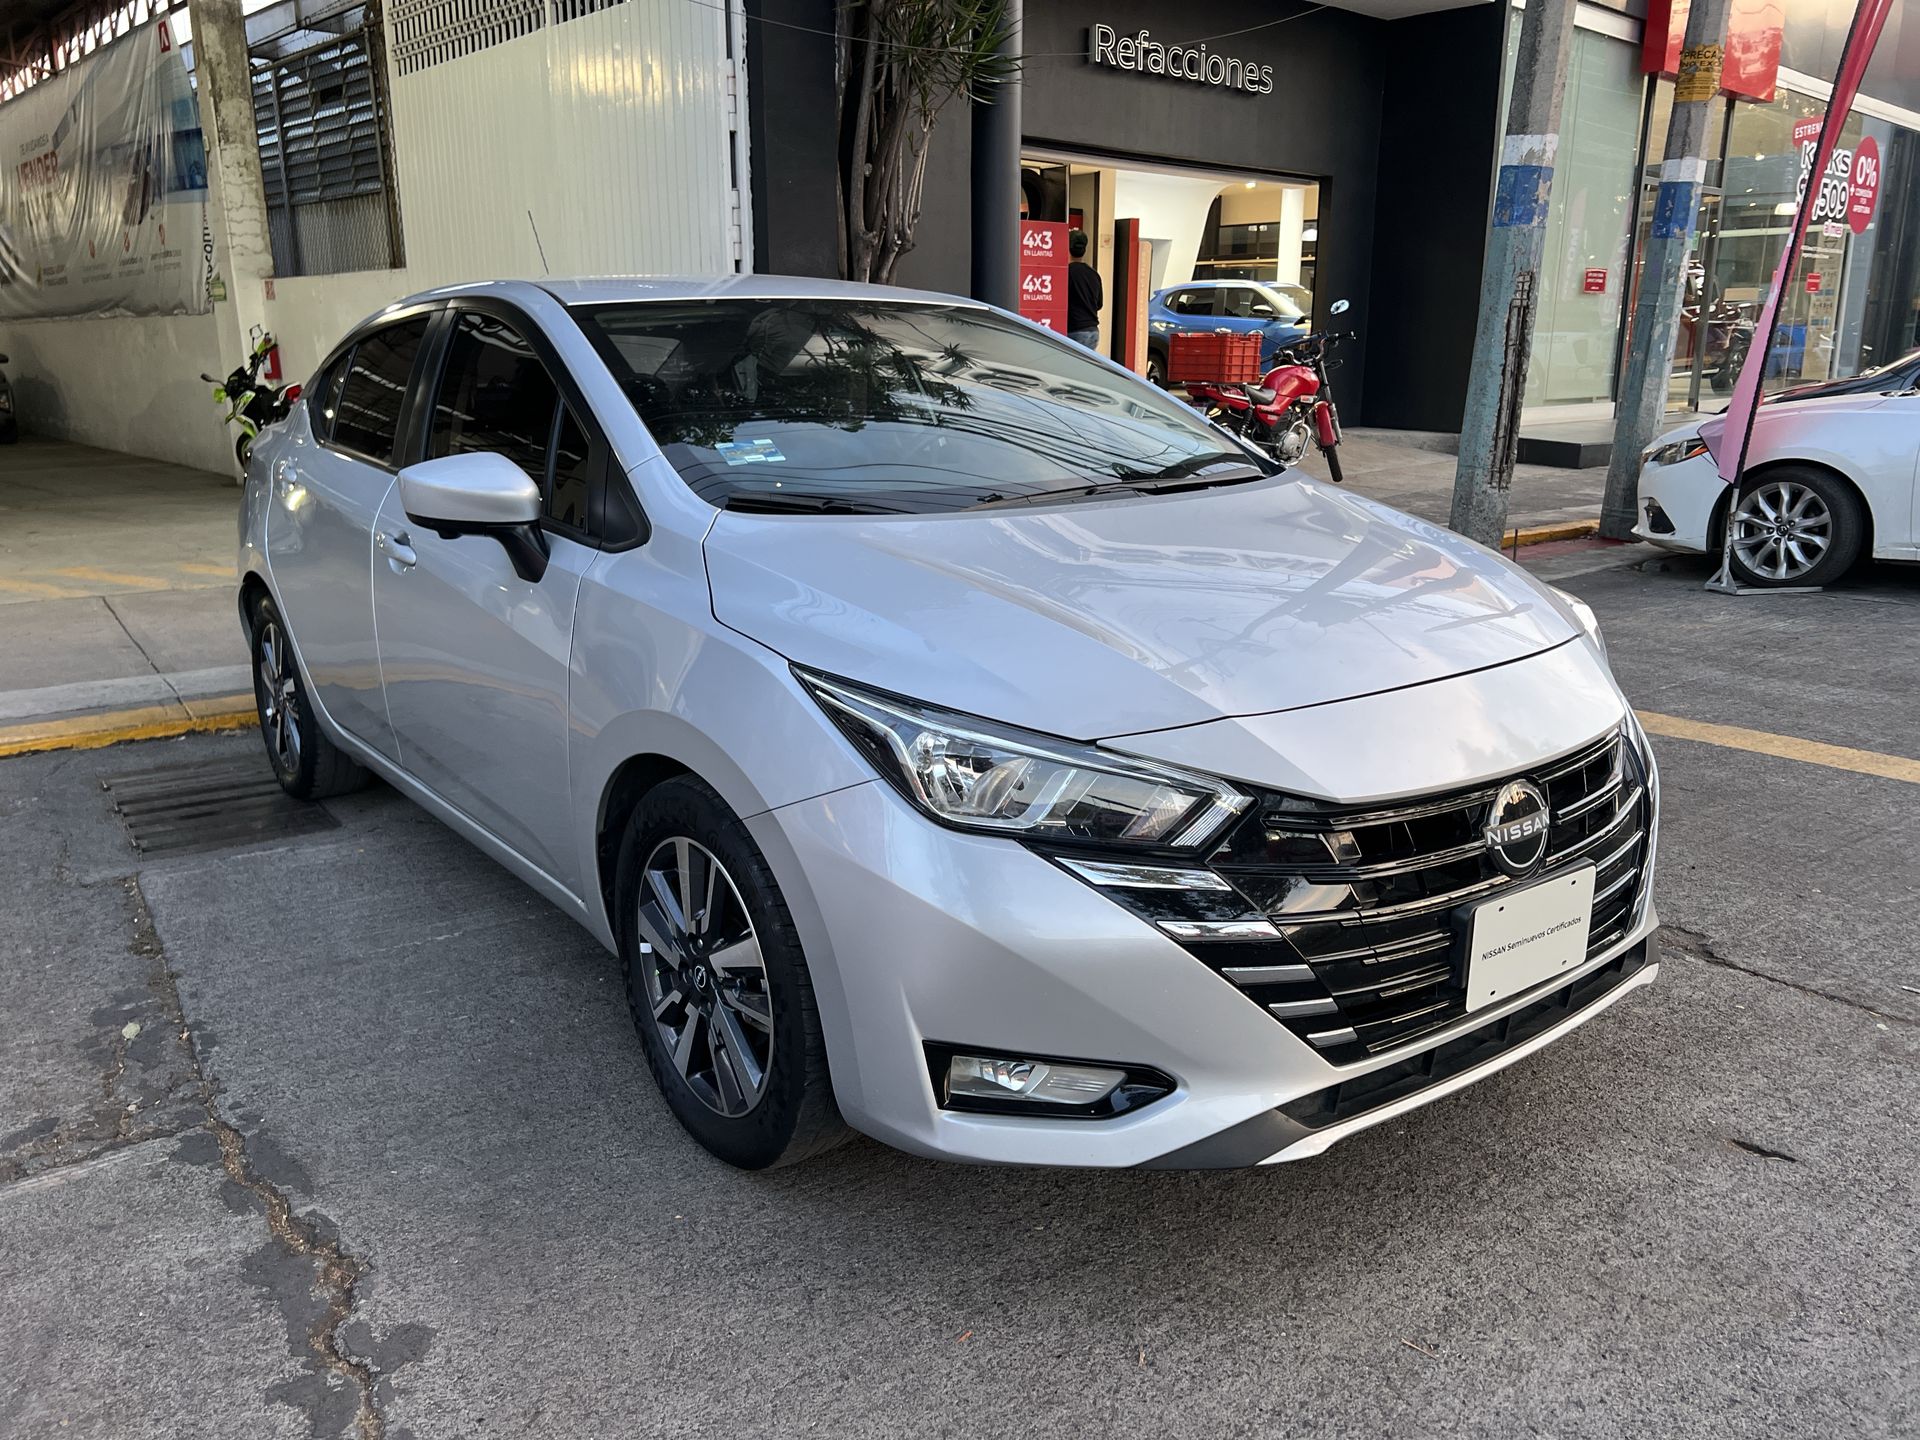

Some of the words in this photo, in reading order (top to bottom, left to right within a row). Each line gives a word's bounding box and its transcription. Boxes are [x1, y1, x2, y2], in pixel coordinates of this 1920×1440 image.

[1094, 24, 1273, 94] Refacciones
[1794, 121, 1823, 139] ESTREN
[1801, 141, 1851, 178] KKS
[1856, 155, 1877, 188] 0%
[1023, 230, 1052, 249] 4x3
[1022, 275, 1052, 293] 4x3
[1487, 806, 1550, 845] NISSAN
[1481, 945, 1507, 960] NISSAN
[1507, 931, 1546, 952] Seminuevos
[1546, 916, 1582, 936] Certificados
